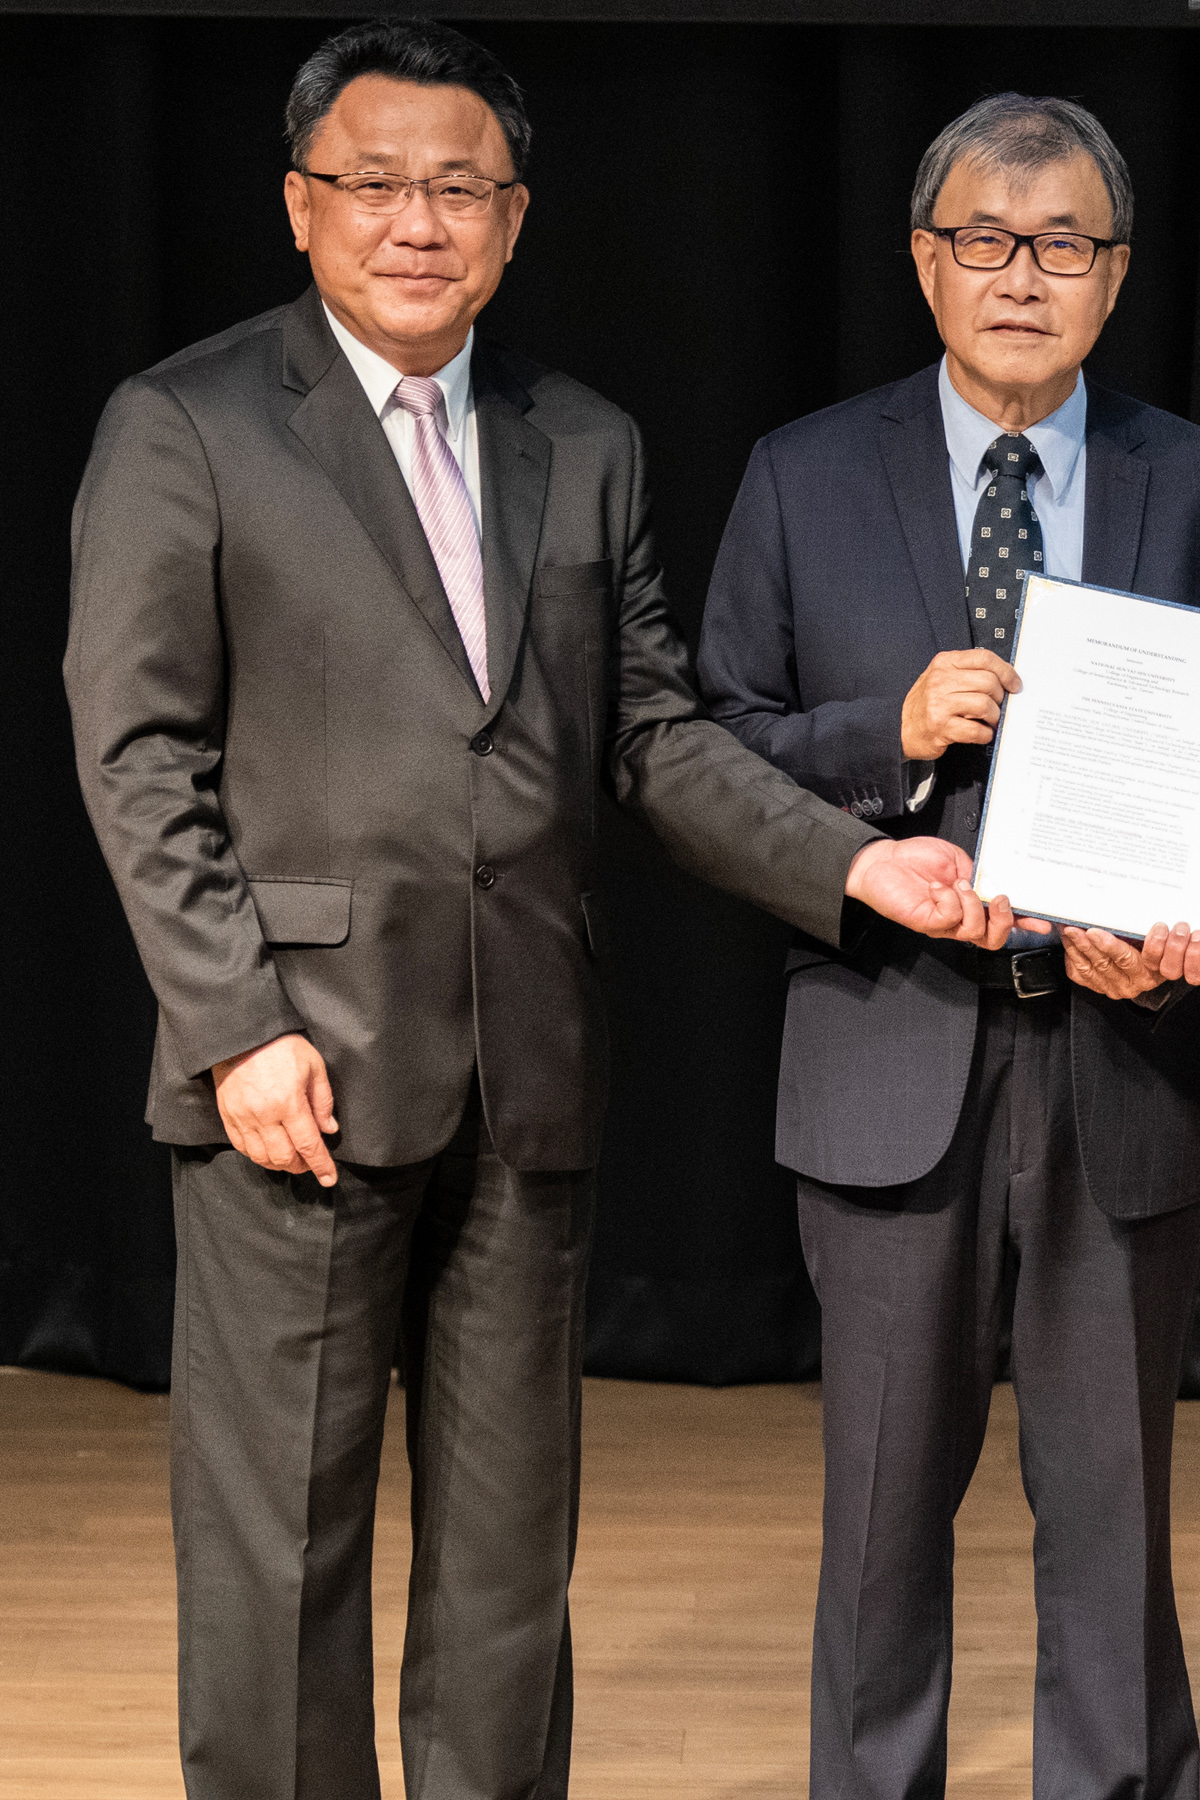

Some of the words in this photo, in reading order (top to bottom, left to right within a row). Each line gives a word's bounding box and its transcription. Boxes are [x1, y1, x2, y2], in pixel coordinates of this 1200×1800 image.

[1086, 637, 1129, 651] MEMORANDUM
[1138, 649, 1186, 663] UNDERSTANDING
[1090, 660, 1114, 669] NATIONAL
[1147, 673, 1175, 682] UNIVERSITY
